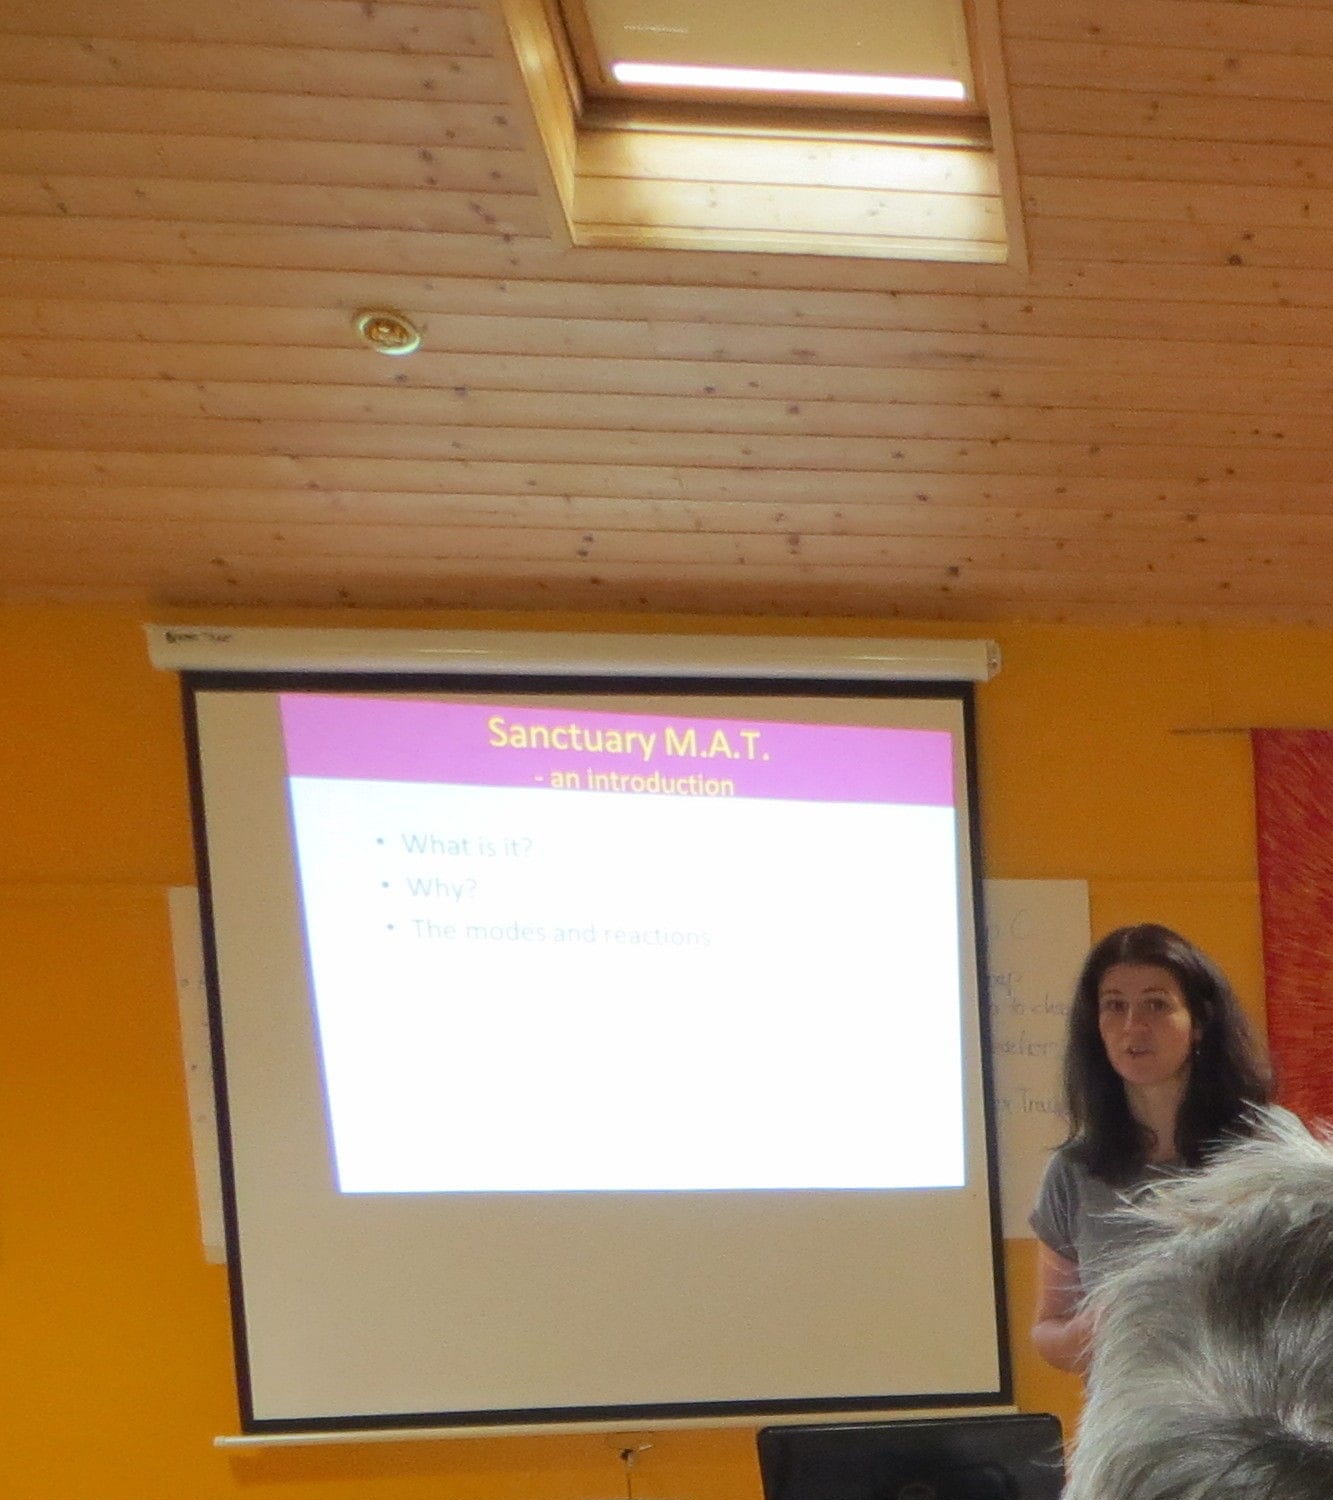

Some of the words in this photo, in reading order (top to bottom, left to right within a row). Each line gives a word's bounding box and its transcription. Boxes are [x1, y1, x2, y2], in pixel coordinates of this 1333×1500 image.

[487, 716, 656, 761] Sanctuary
[664, 726, 770, 761] M.A.T.
[551, 770, 580, 789] an
[588, 767, 734, 796] introduction
[401, 832, 472, 856] What
[478, 836, 495, 857] is
[504, 836, 534, 858] it?
[406, 877, 479, 902] Why?
[412, 918, 457, 941] The
[466, 921, 546, 943] modes
[553, 923, 596, 944] and
[603, 926, 712, 947] reactions
